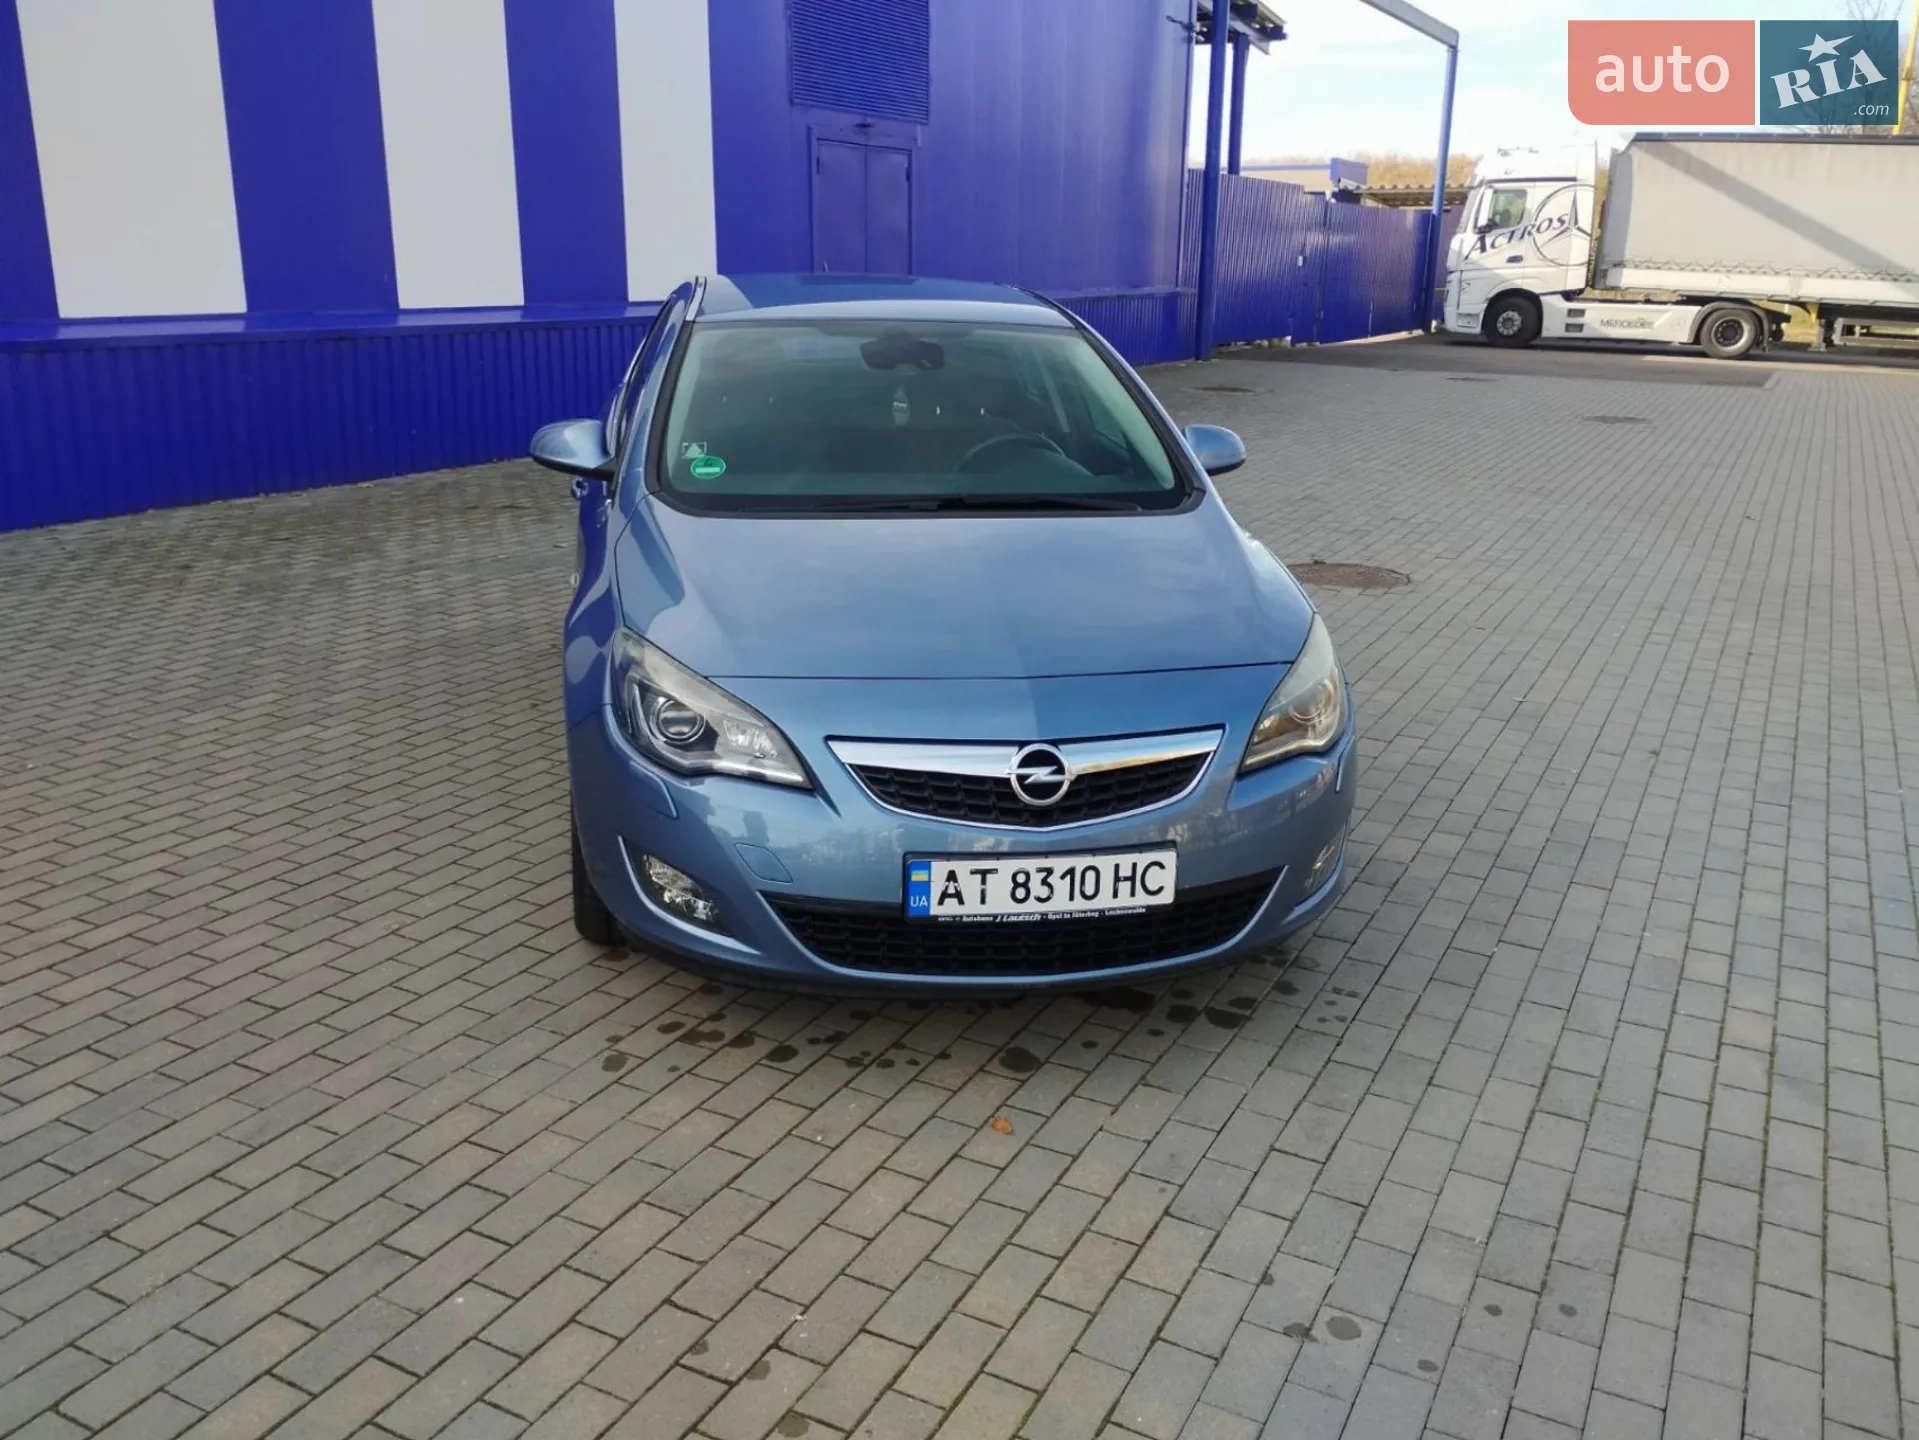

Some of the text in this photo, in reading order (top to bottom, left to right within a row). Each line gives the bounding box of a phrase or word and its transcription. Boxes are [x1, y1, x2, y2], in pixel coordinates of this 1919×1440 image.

[937, 861, 1167, 906] AT 8310 HC
[910, 896, 928, 907] UA
